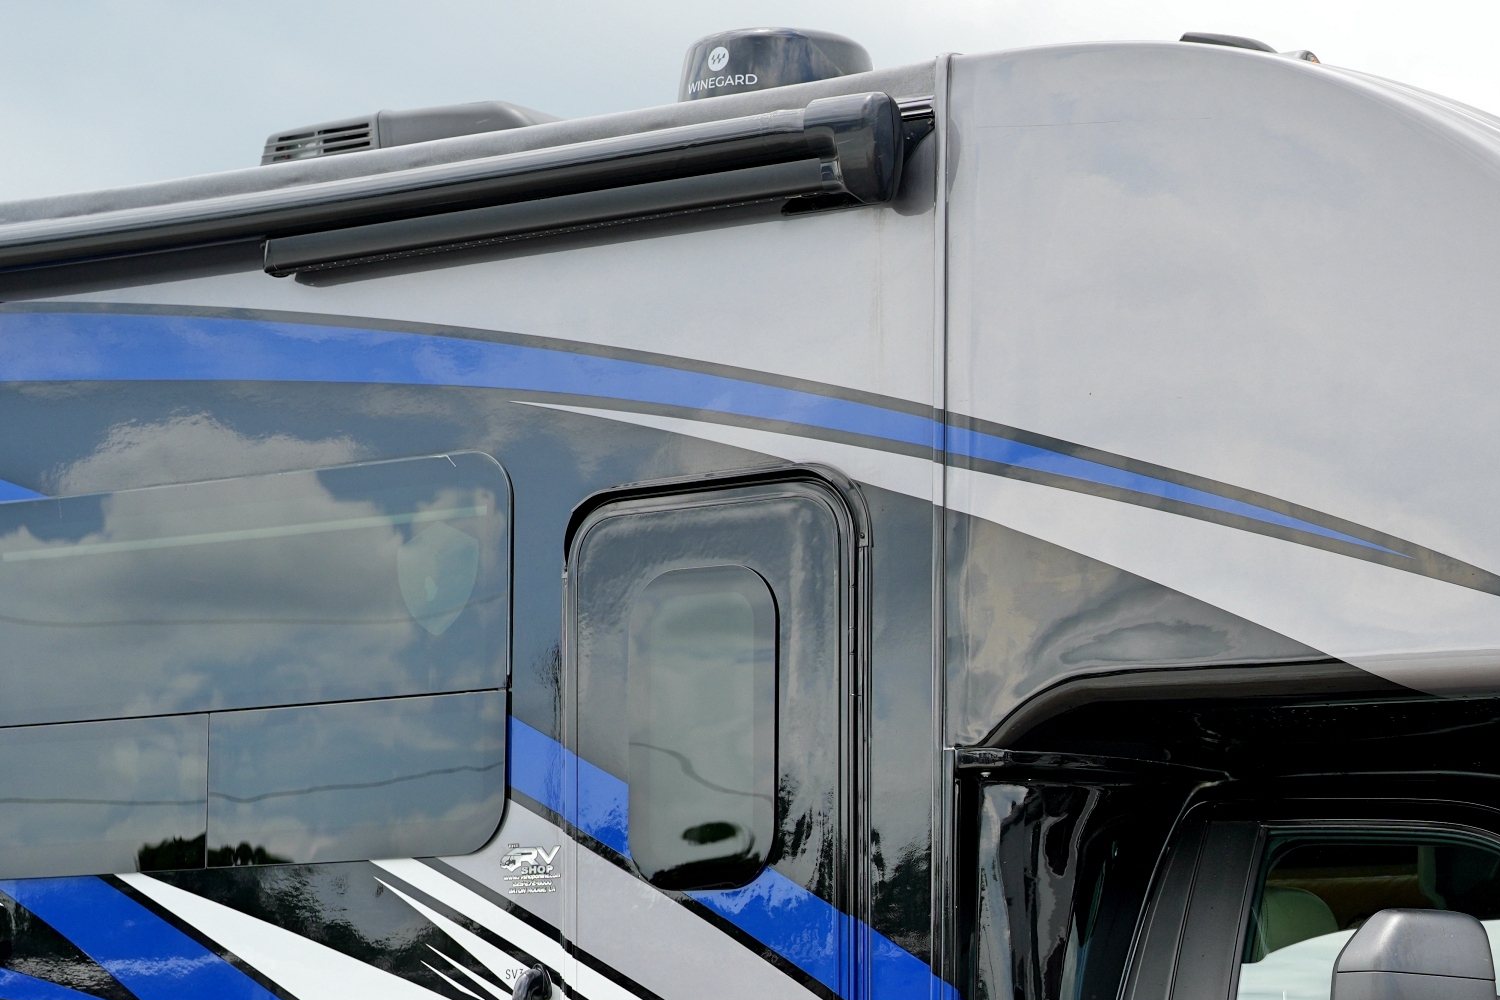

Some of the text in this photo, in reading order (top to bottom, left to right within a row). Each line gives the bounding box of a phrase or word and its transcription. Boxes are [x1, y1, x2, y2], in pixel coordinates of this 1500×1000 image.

[688, 73, 758, 94] WINEGARD
[507, 845, 561, 867] RV
[521, 864, 554, 875] SHOP
